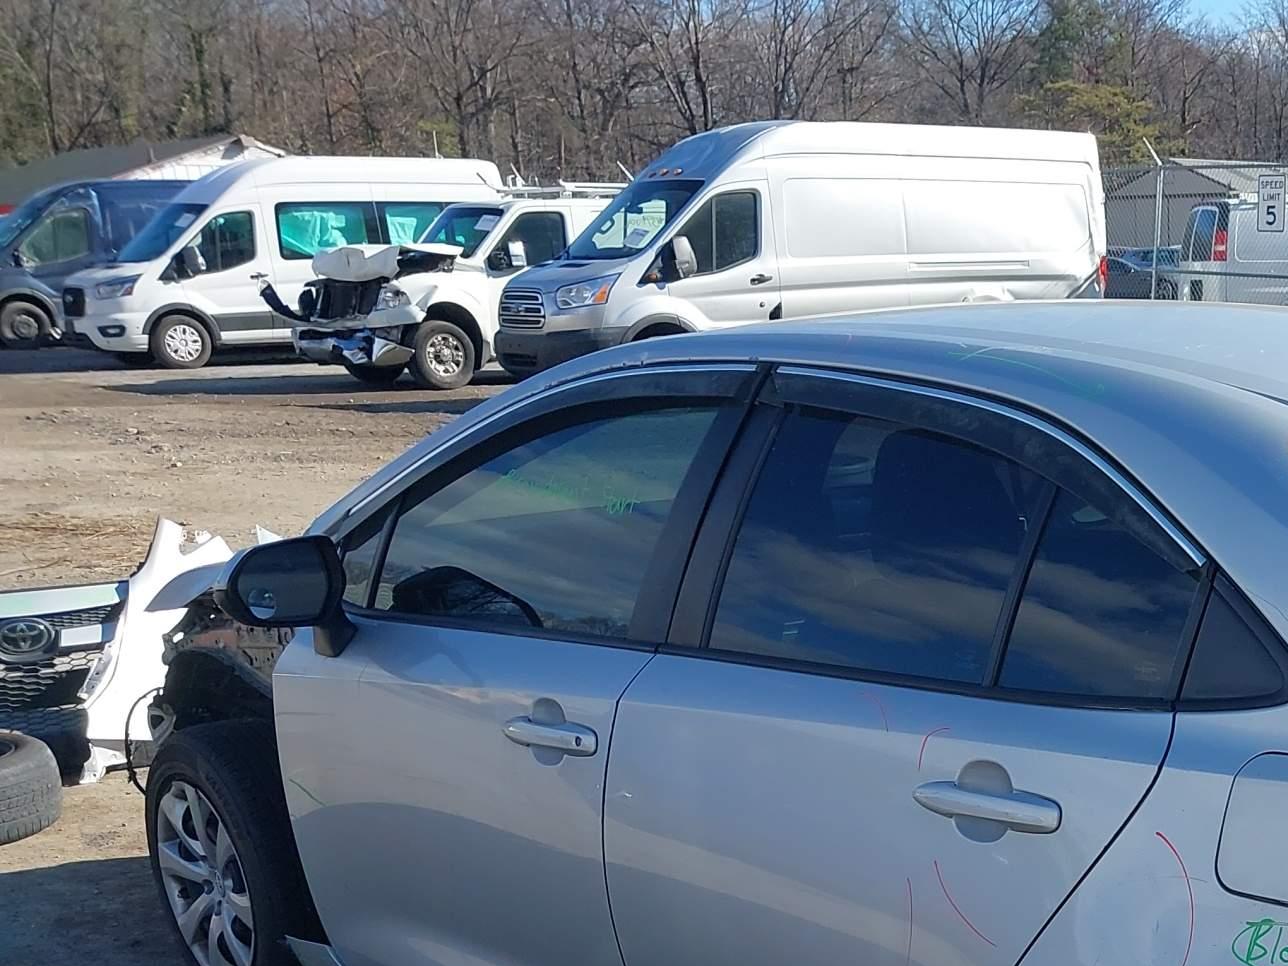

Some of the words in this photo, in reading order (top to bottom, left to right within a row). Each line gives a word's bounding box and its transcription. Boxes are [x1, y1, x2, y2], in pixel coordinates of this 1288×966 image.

[1260, 180, 1284, 190] SPEED
[1262, 192, 1281, 202] LIMIT
[1265, 204, 1277, 226] 5
